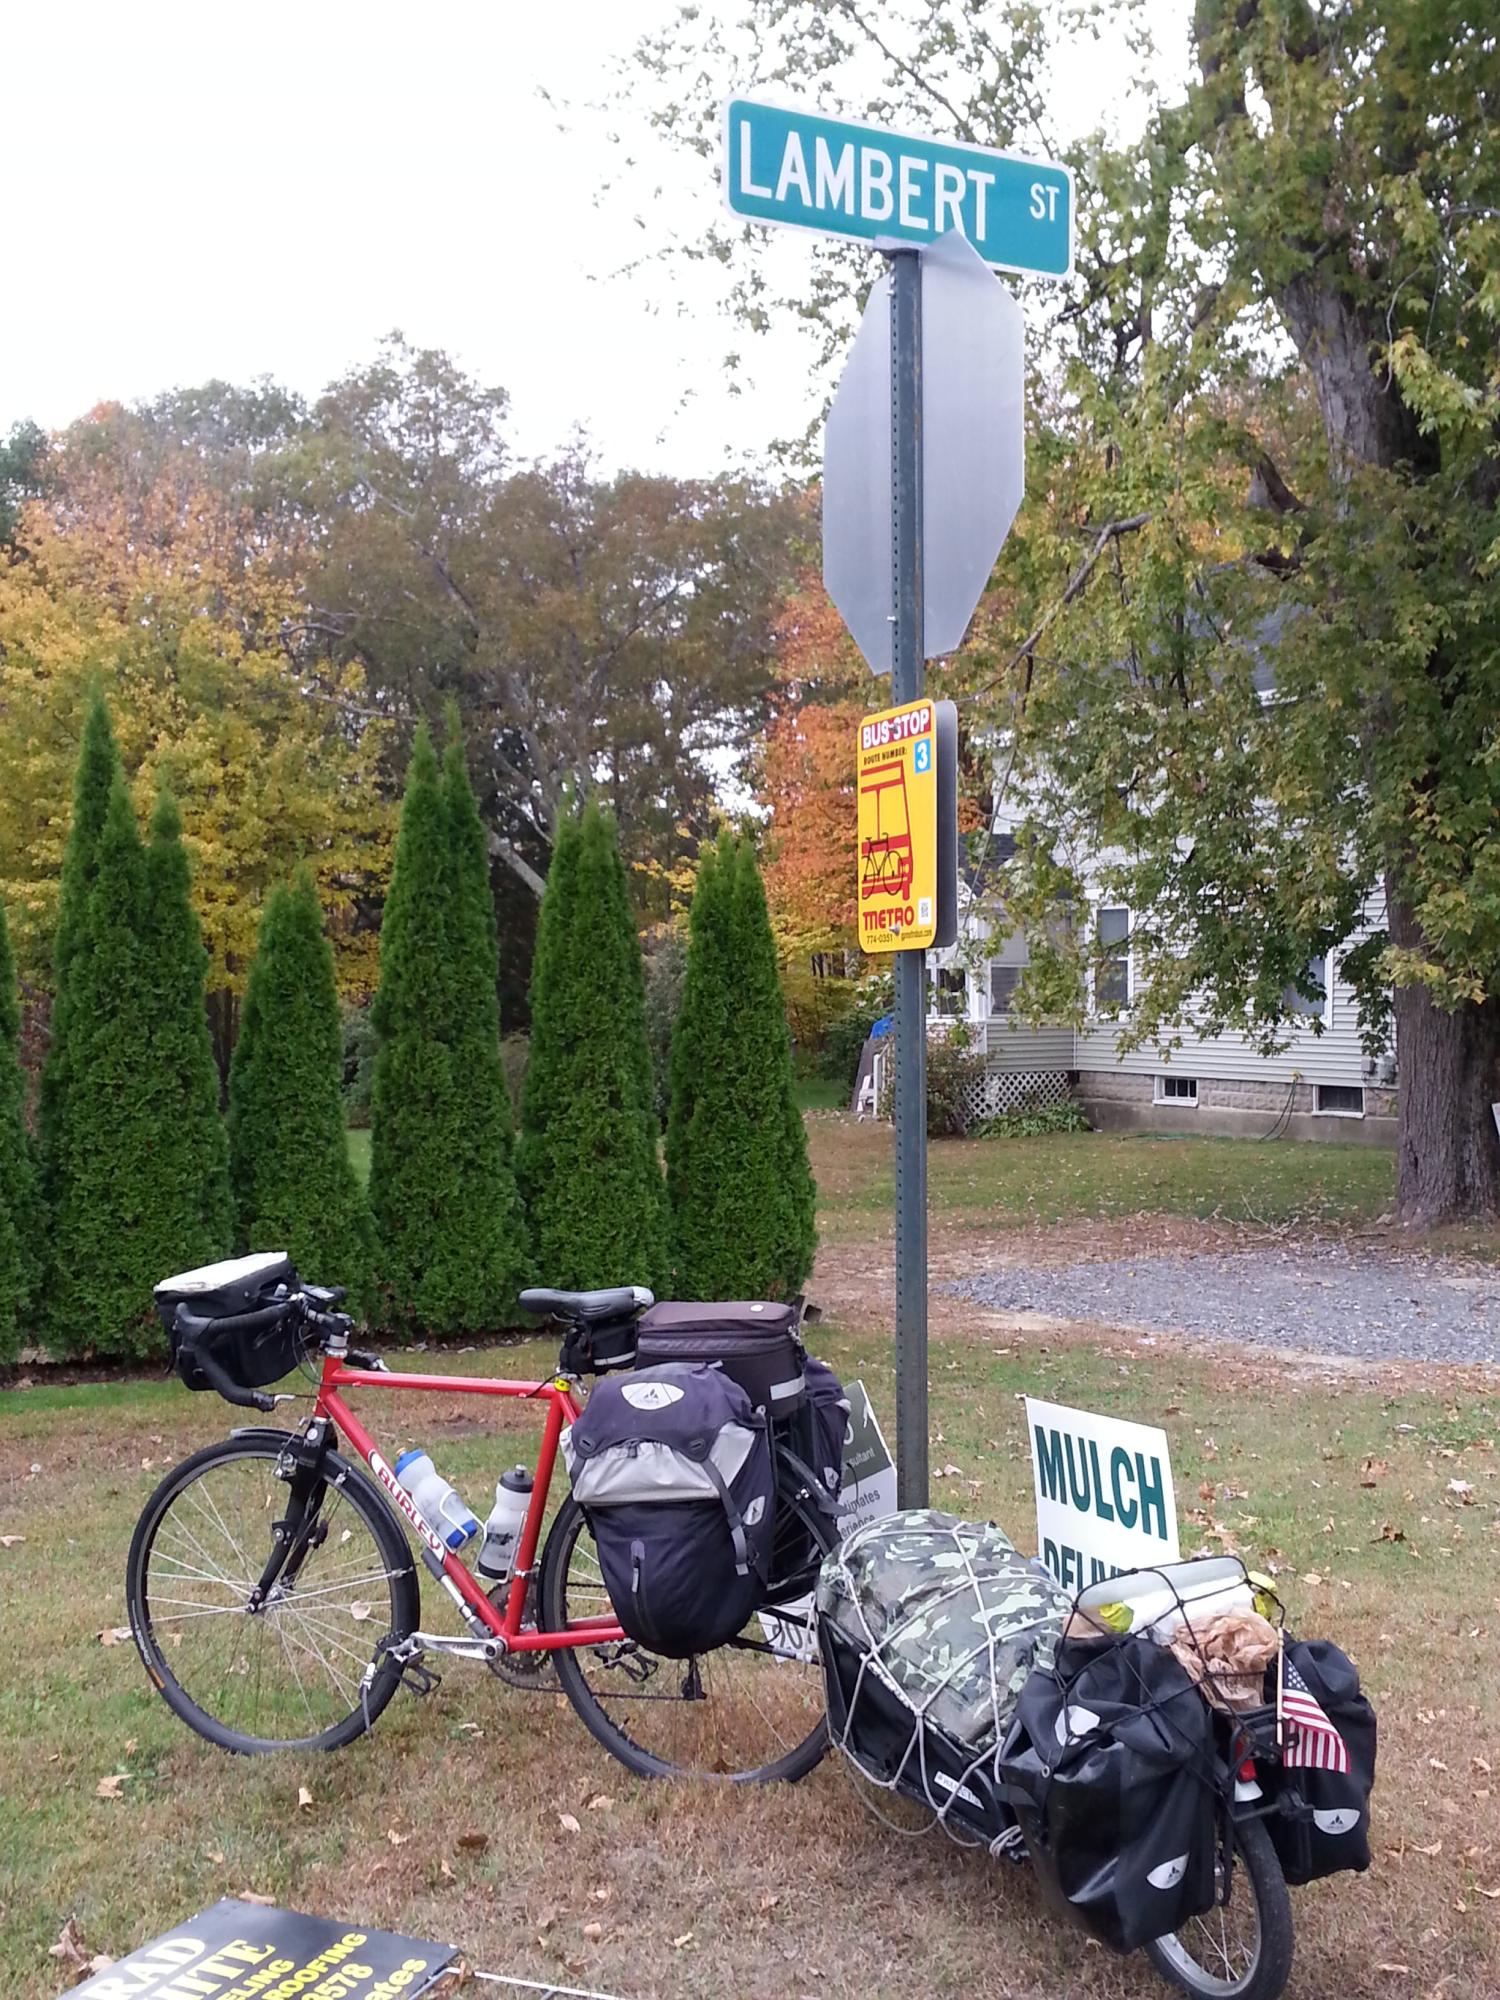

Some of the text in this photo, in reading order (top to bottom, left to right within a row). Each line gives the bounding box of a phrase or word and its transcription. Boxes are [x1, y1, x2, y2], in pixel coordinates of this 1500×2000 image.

[740, 120, 1060, 242] LAMBERT ST
[863, 708, 930, 749] BUS STOP
[917, 742, 928, 770] 3
[862, 905, 915, 932] METRO
[378, 1467, 442, 1550] BURLEY
[1034, 1425, 1168, 1541] MULCH
